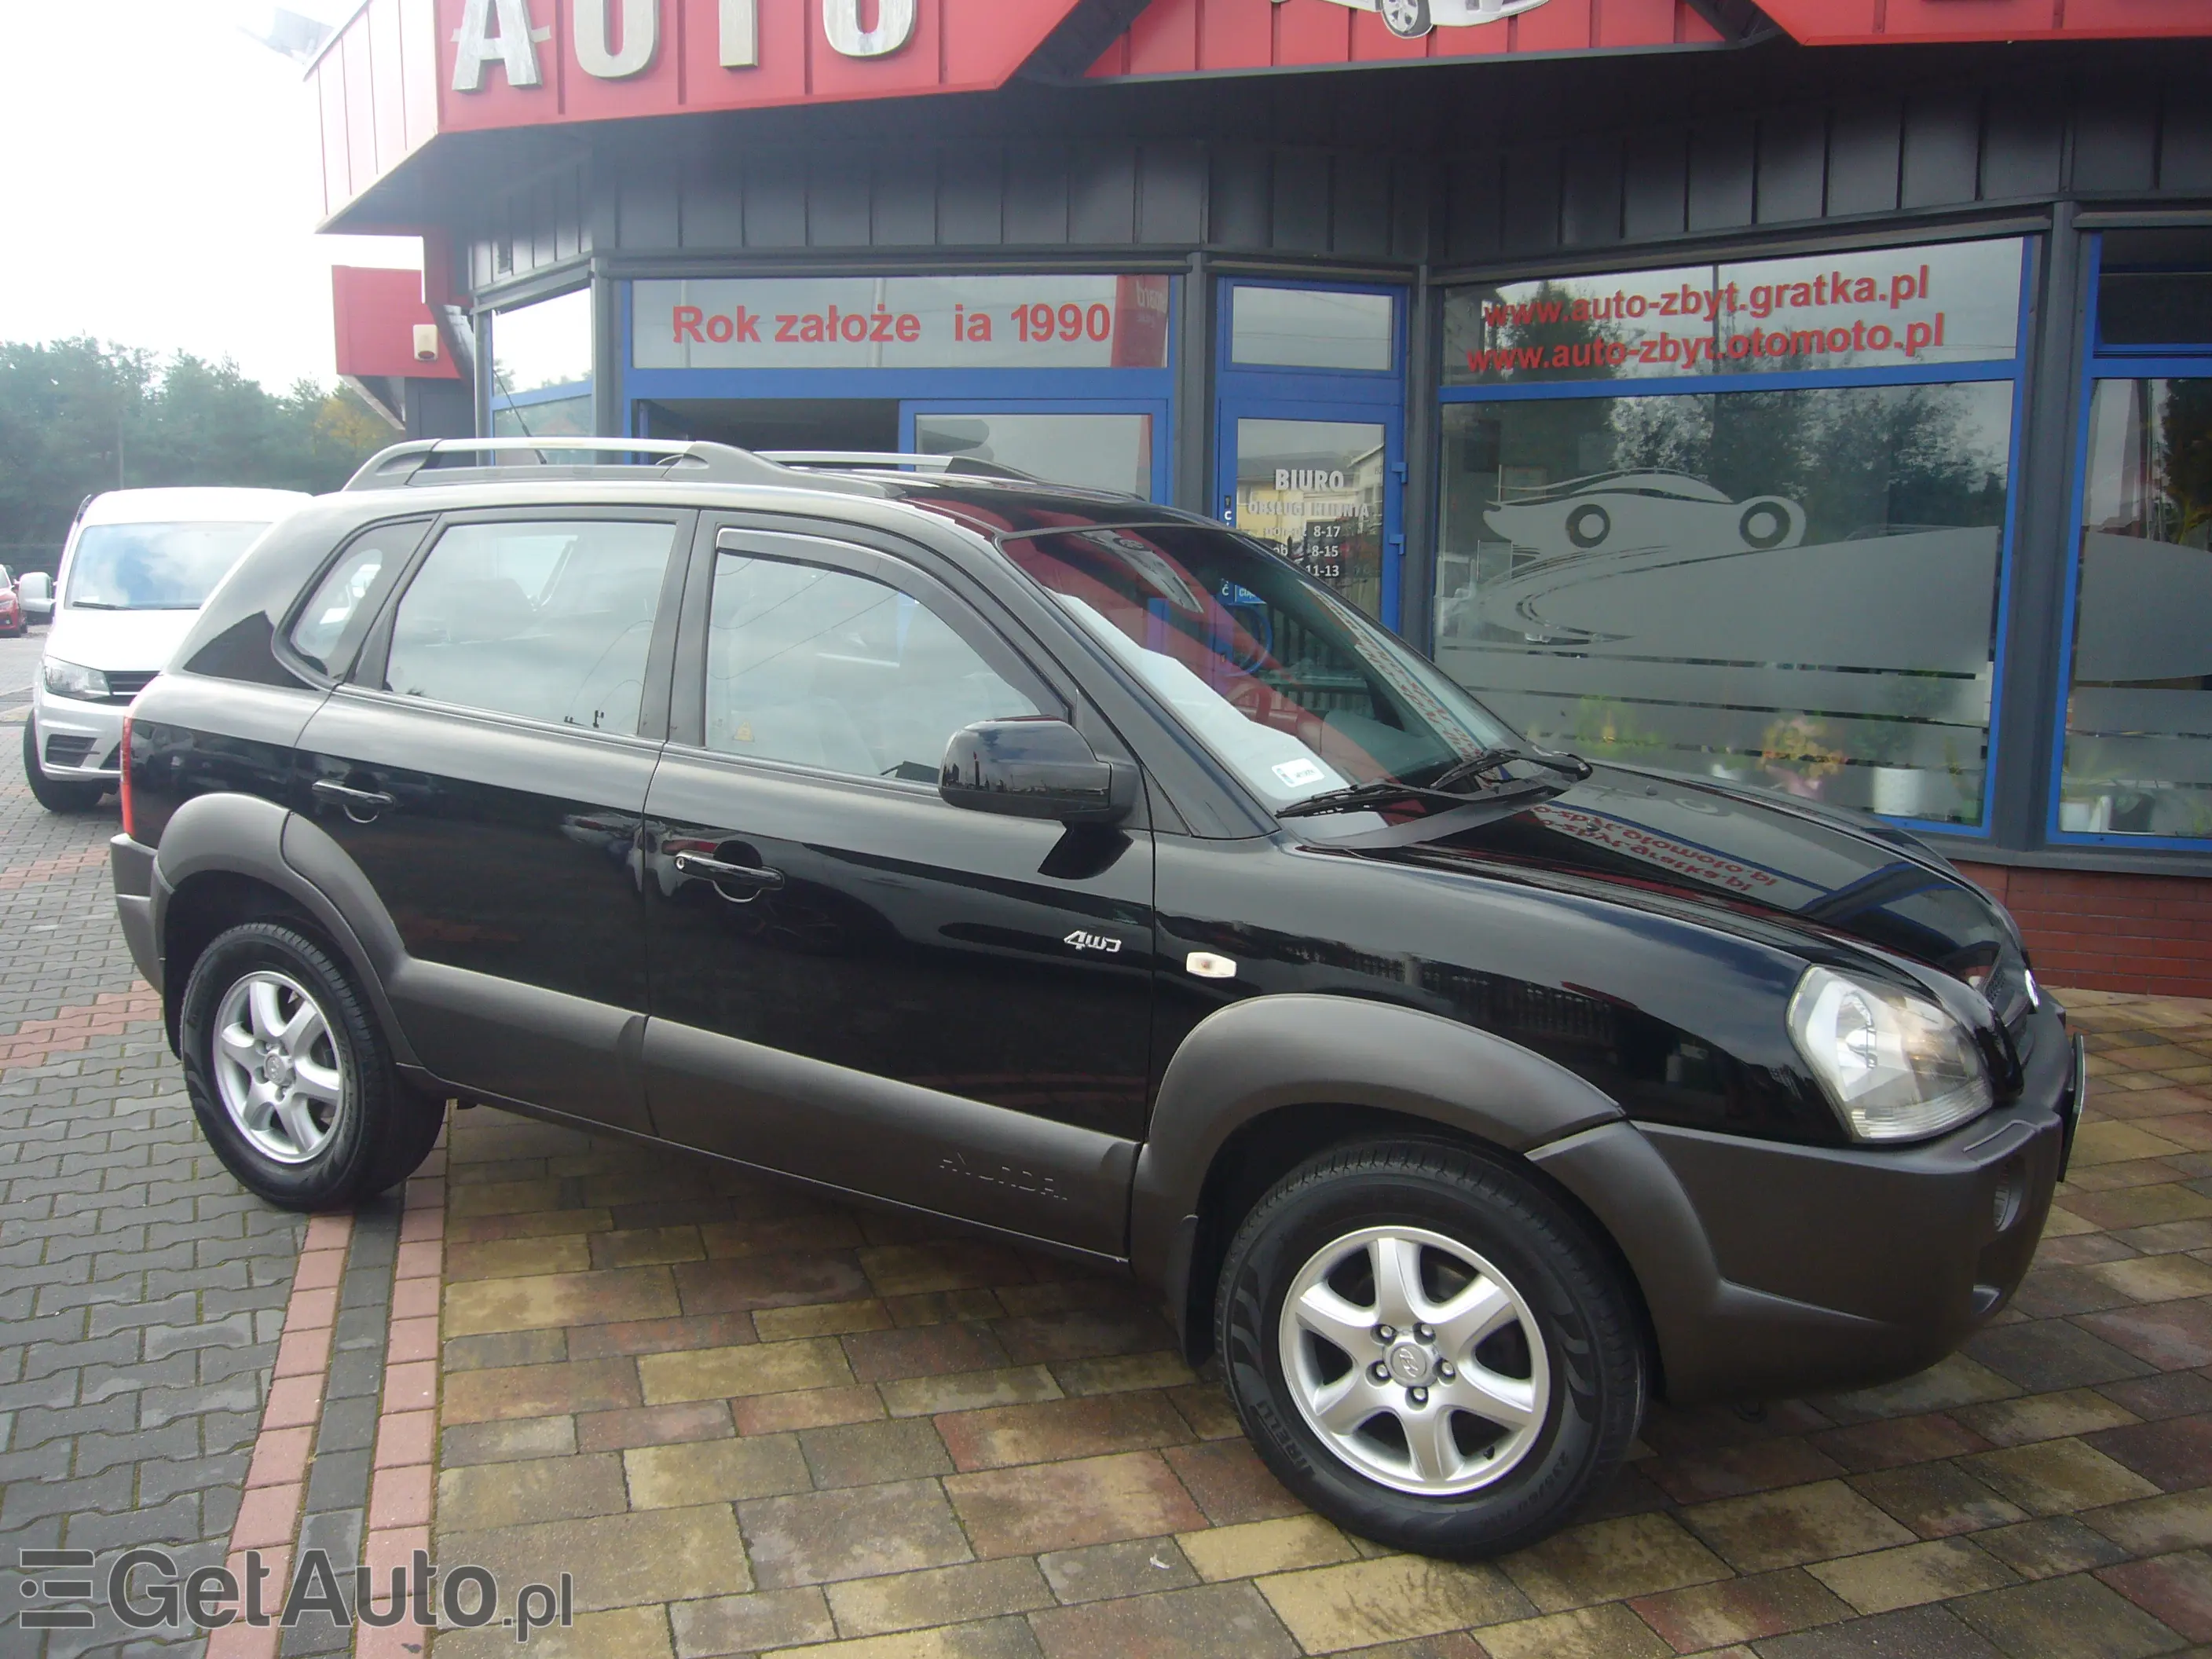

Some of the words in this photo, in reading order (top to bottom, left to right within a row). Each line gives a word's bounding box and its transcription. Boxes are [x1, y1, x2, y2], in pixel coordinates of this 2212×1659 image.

[1484, 264, 1929, 327] www.auto-zbyt.gratka.pl
[672, 305, 762, 343] Rok
[1011, 303, 1111, 342] 1990
[1467, 312, 1944, 372] www.auto-zbyt.otomoto.pl
[1275, 469, 1345, 493] BIURO
[1313, 525, 1341, 537] 8-17
[1311, 545, 1339, 557] 8-15
